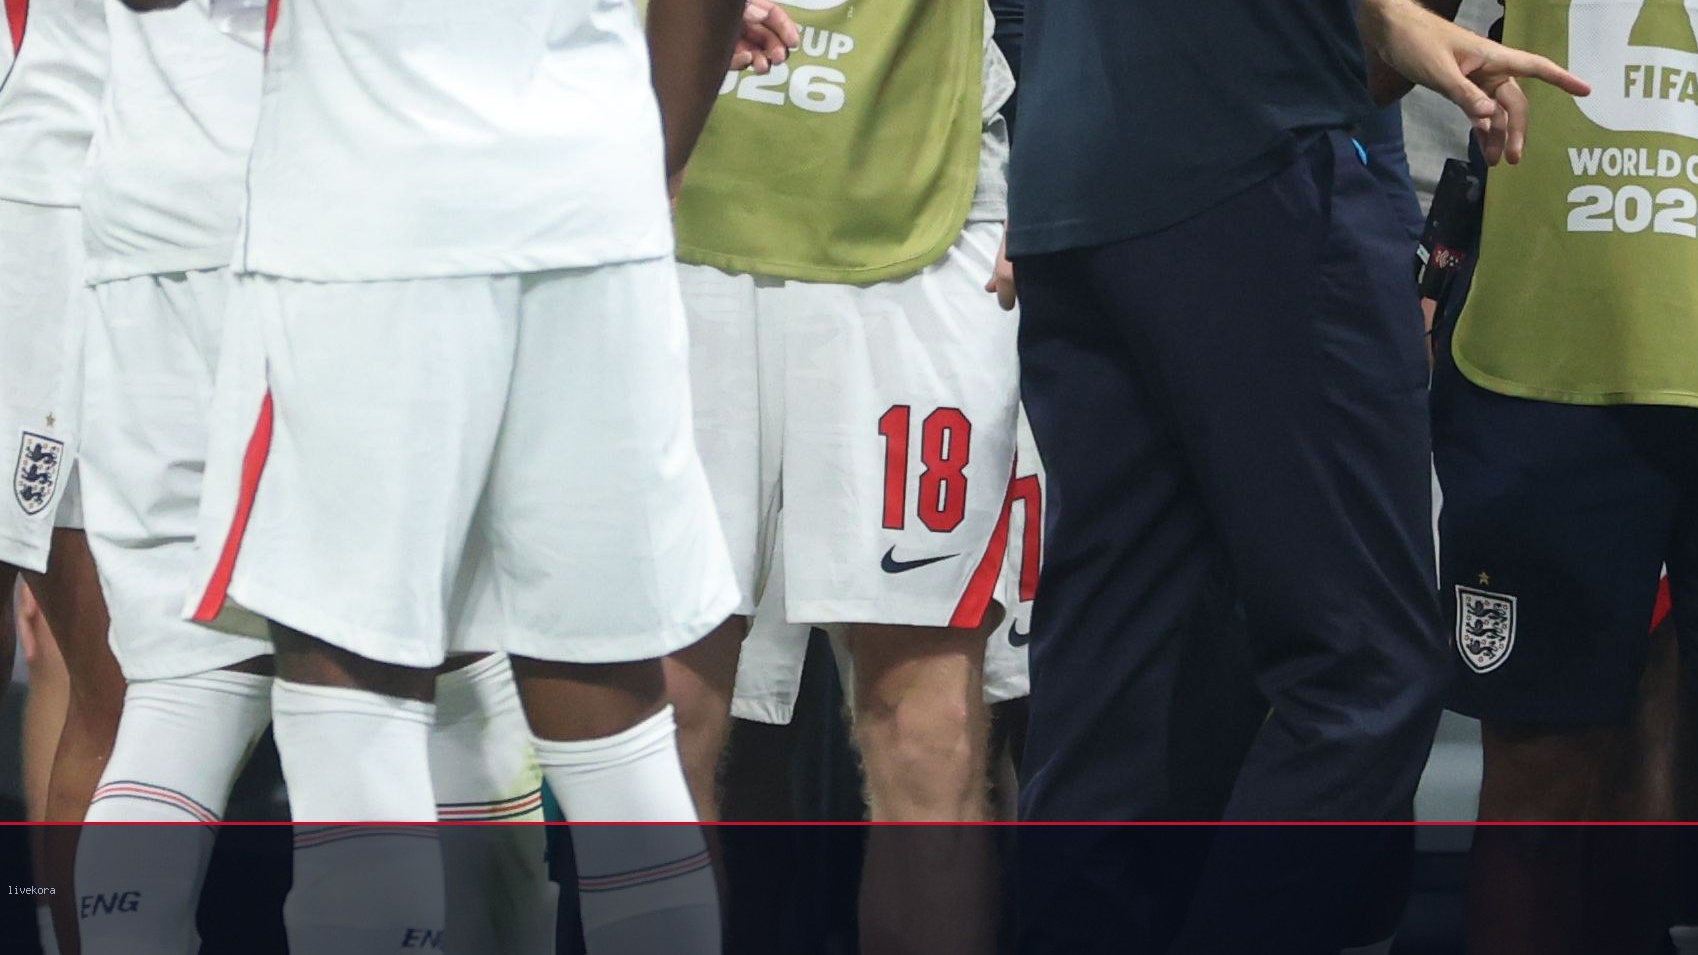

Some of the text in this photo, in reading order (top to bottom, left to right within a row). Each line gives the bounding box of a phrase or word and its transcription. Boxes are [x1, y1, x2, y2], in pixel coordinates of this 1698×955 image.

[788, 22, 854, 61] UP
[1567, 147, 1682, 178] WORLD
[877, 404, 972, 533] 18
[81, 891, 141, 919] ENG
[401, 927, 444, 949] EN
